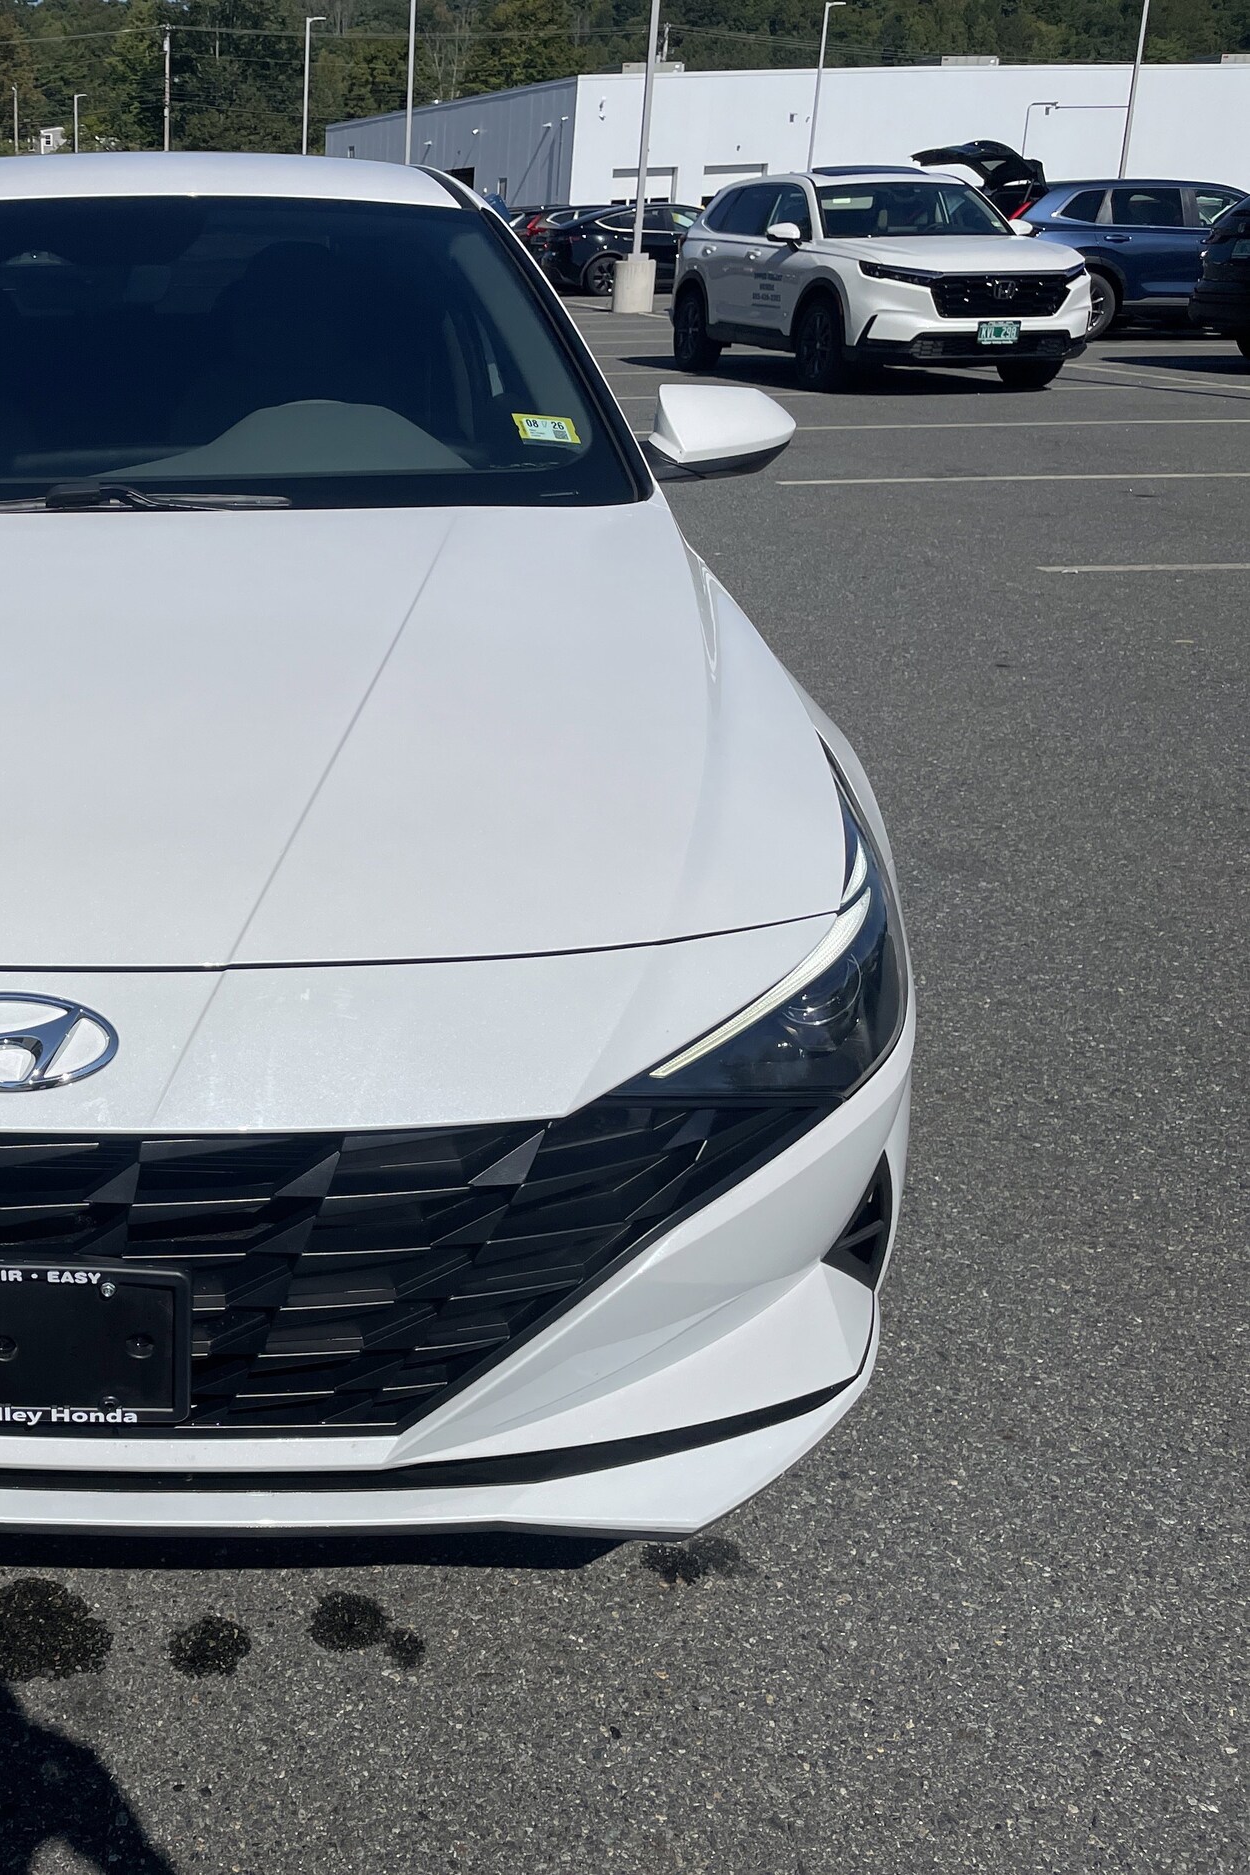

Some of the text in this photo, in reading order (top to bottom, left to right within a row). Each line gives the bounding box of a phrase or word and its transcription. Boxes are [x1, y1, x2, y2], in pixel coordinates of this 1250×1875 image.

[525, 419, 564, 430] 08 26
[47, 1271, 101, 1285] EASY
[51, 1407, 138, 1423] Honda
